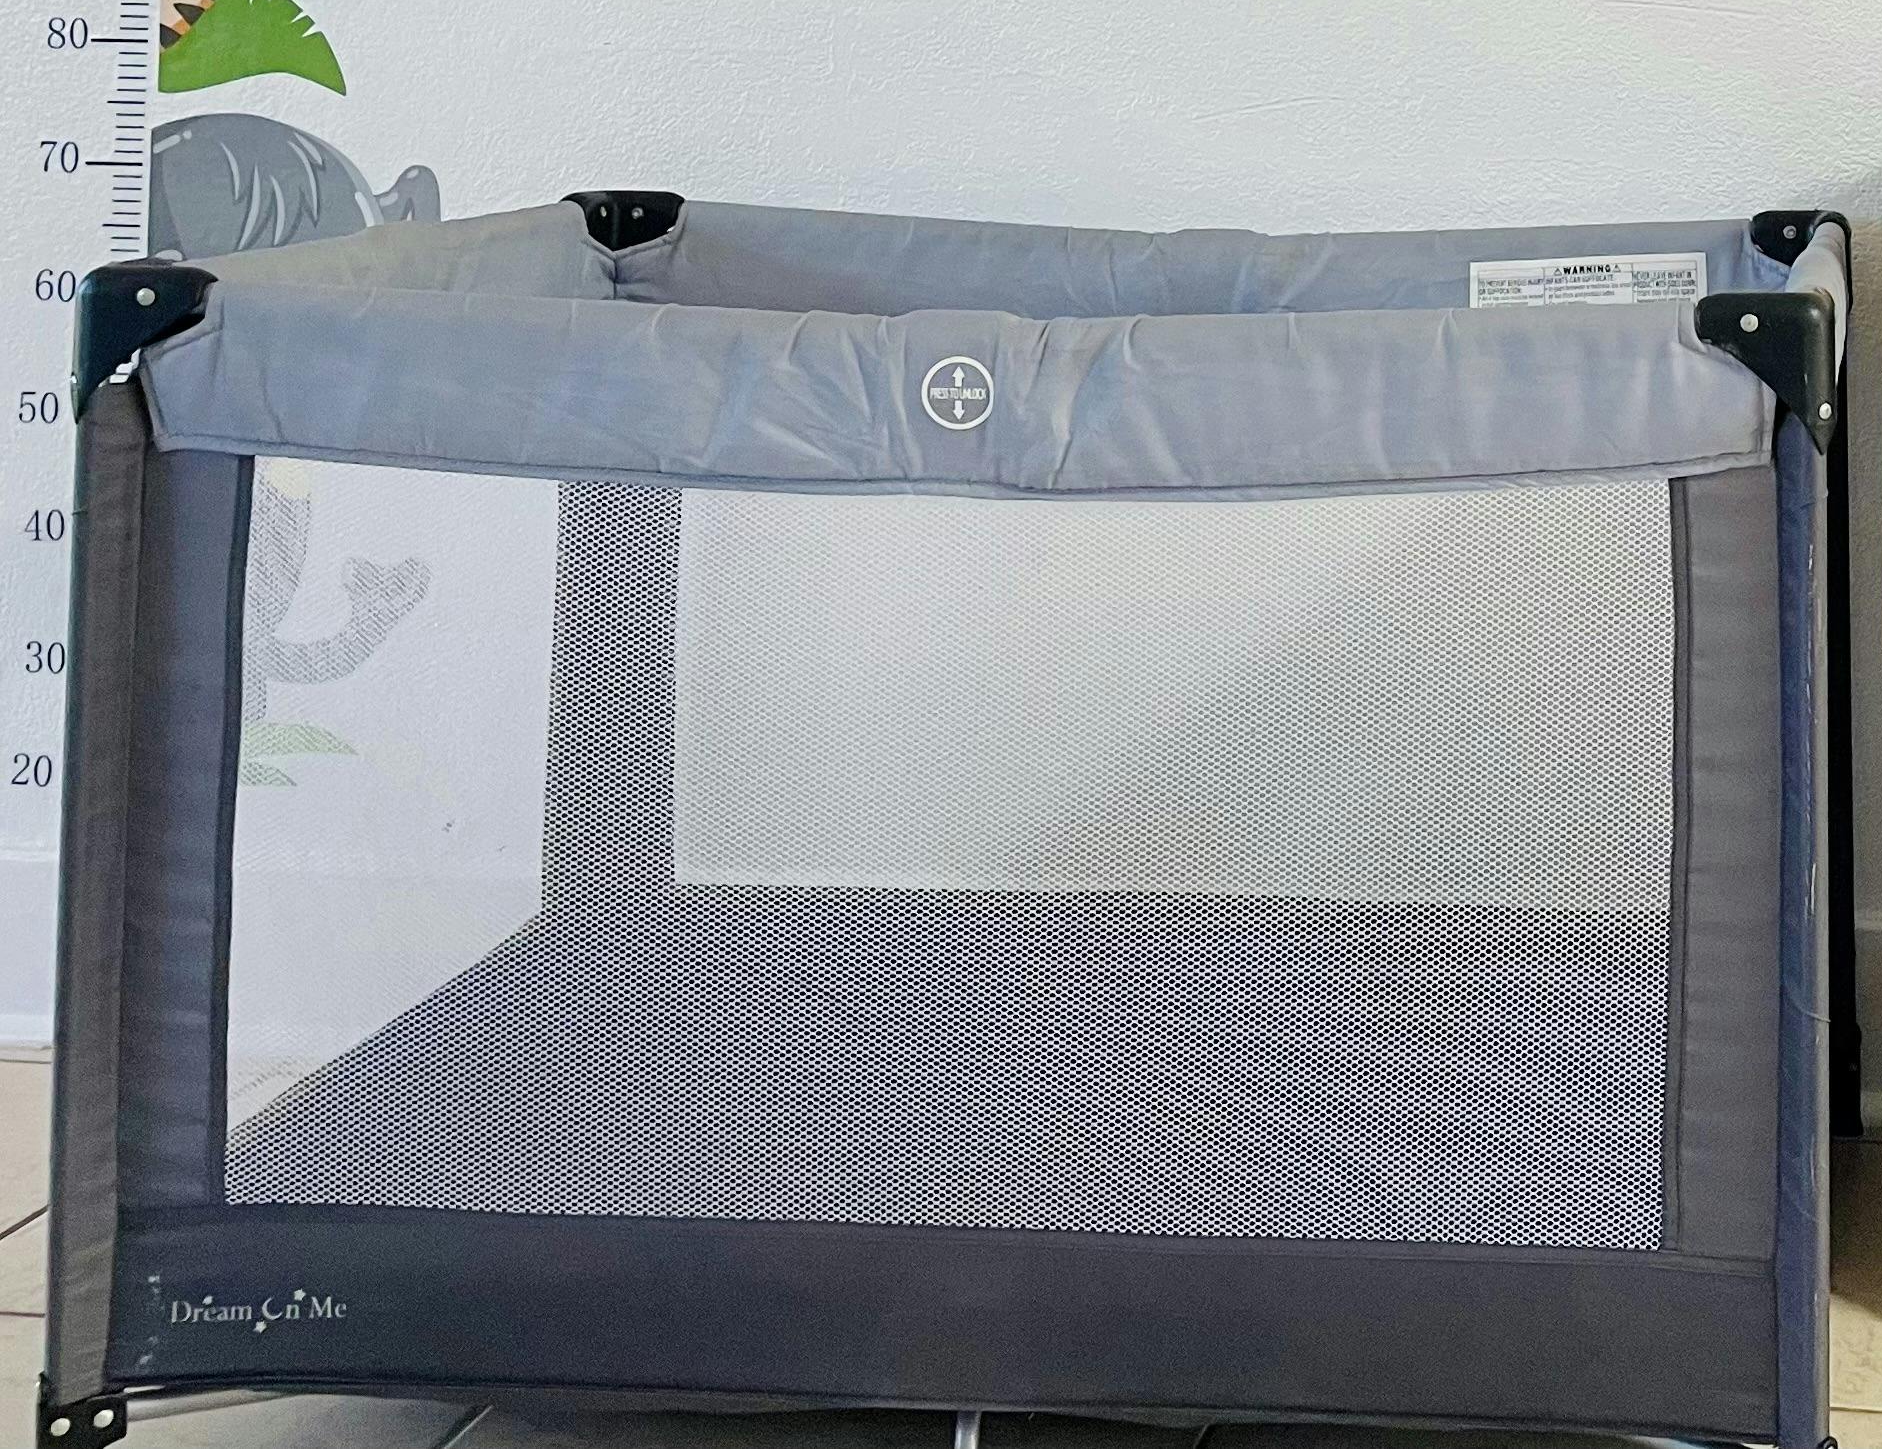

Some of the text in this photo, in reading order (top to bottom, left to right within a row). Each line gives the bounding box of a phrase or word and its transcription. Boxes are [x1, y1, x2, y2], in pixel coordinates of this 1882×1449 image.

[47, 17, 88, 49] 80
[40, 141, 80, 173] 70
[35, 270, 76, 302] 60
[1563, 264, 1611, 276] WARNING
[18, 392, 59, 424] 50
[24, 509, 65, 542] 40
[25, 641, 65, 674] 30
[11, 753, 52, 787] 20
[171, 1299, 252, 1324] Dream
[308, 1296, 347, 1319] Me
